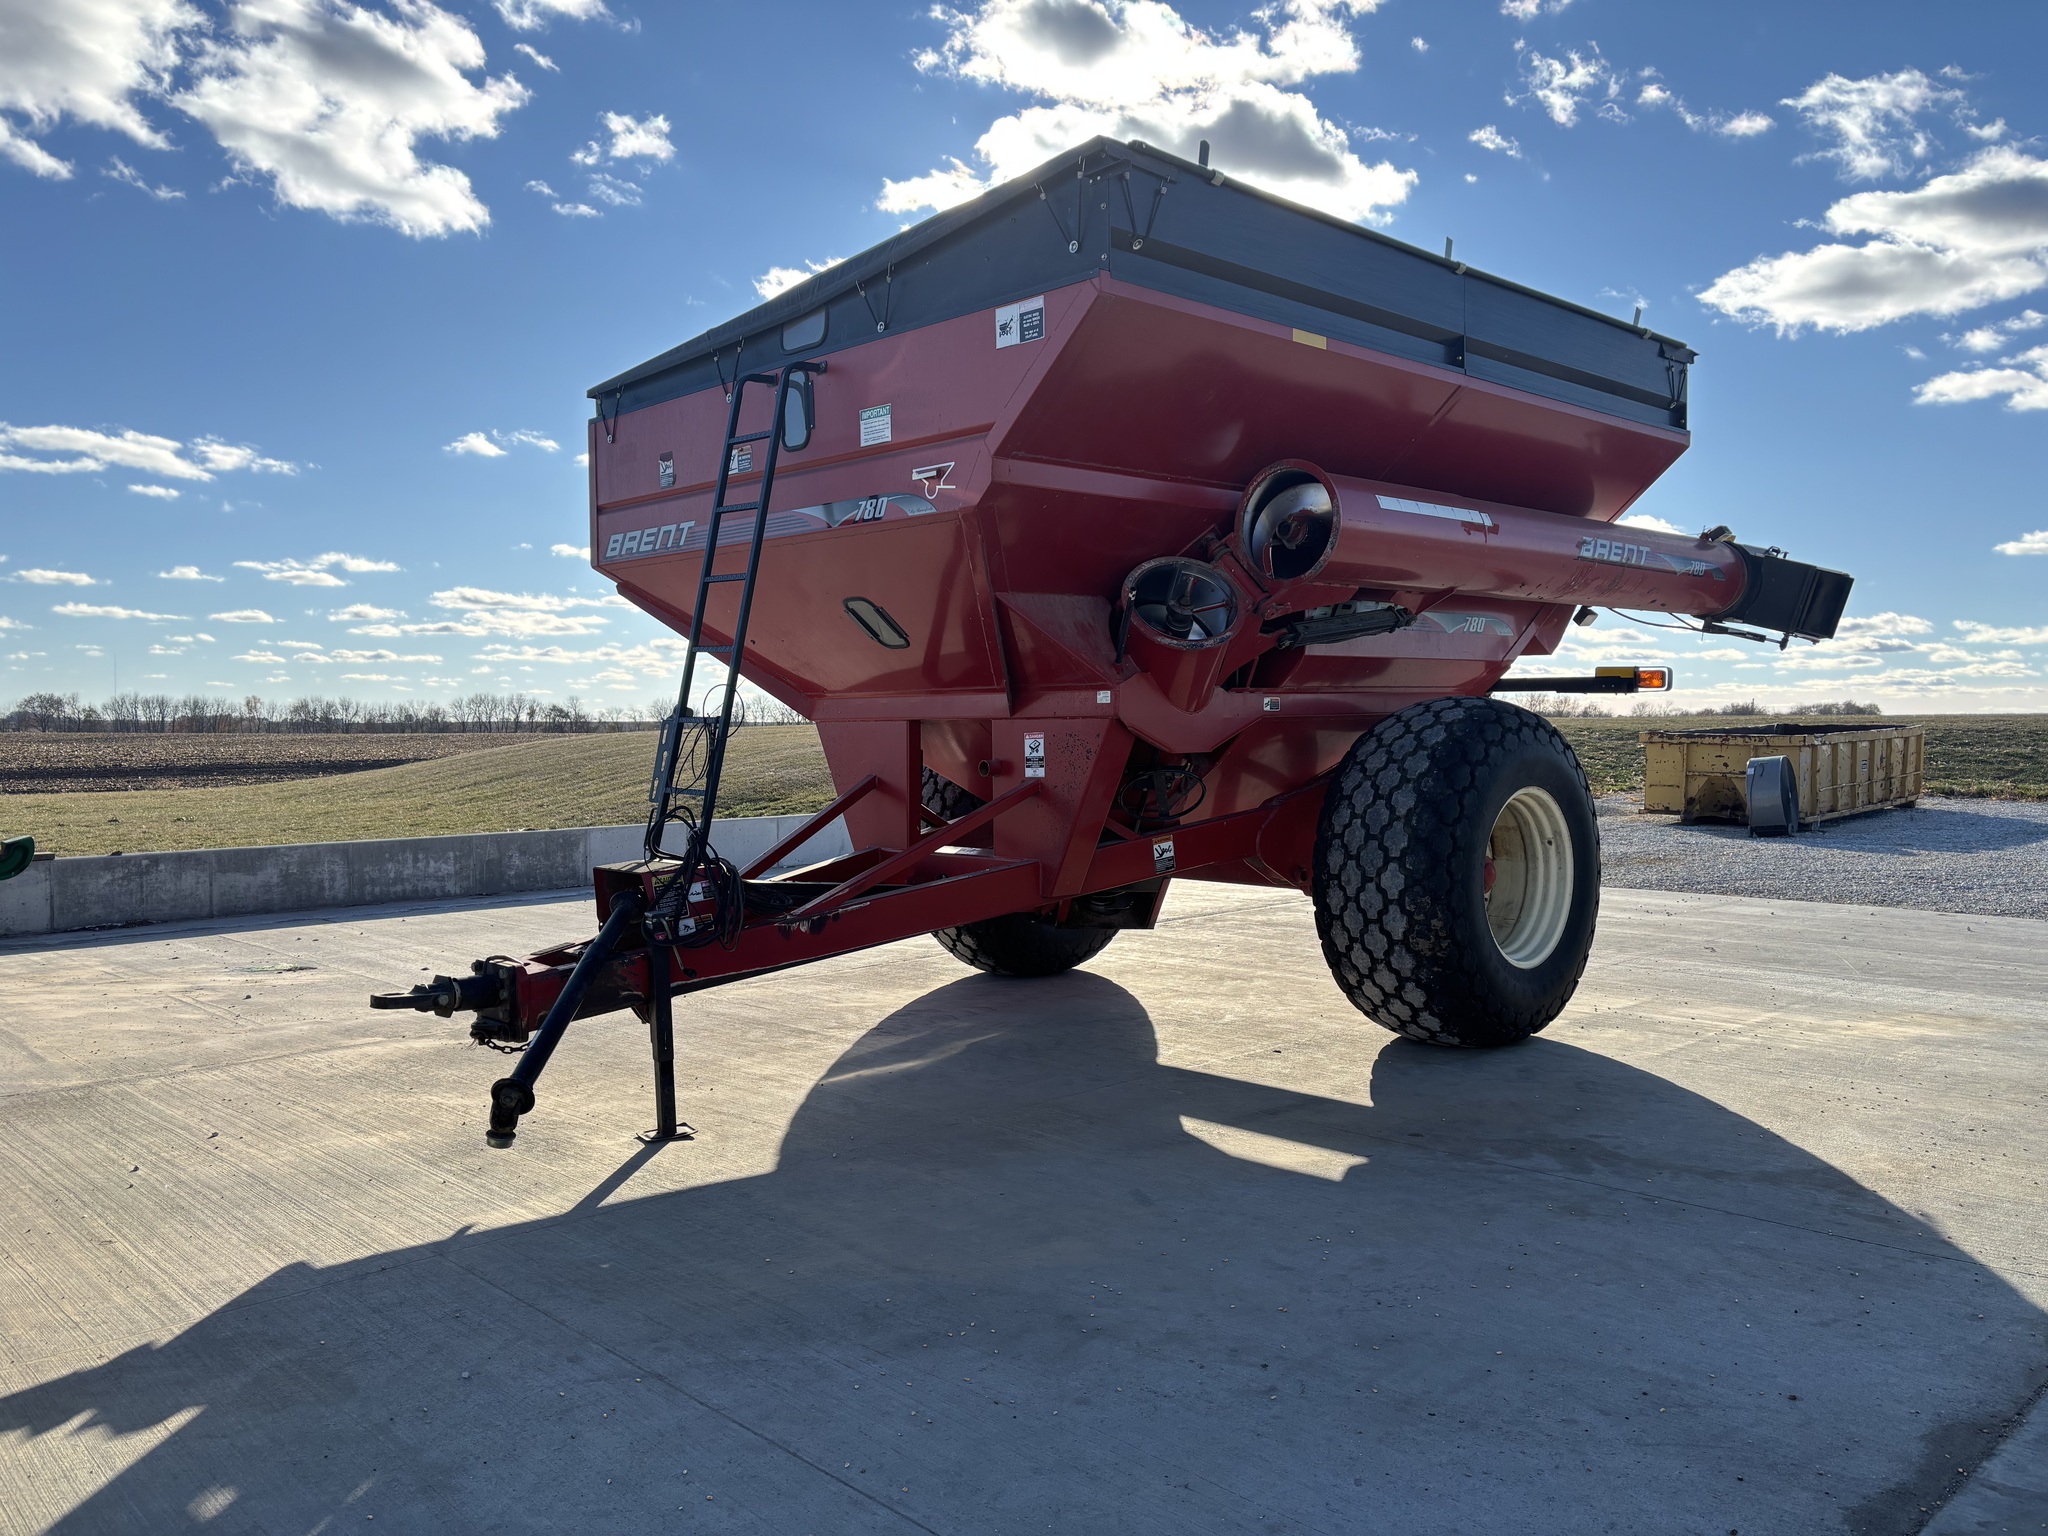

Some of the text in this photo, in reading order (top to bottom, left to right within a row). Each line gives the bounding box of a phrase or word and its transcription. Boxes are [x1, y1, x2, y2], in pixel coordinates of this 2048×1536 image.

[862, 406, 889, 420] IMPORTANT
[606, 497, 888, 557] BRENT 780
[1579, 536, 1706, 576] BRENT 780
[1463, 617, 1486, 632] 780
